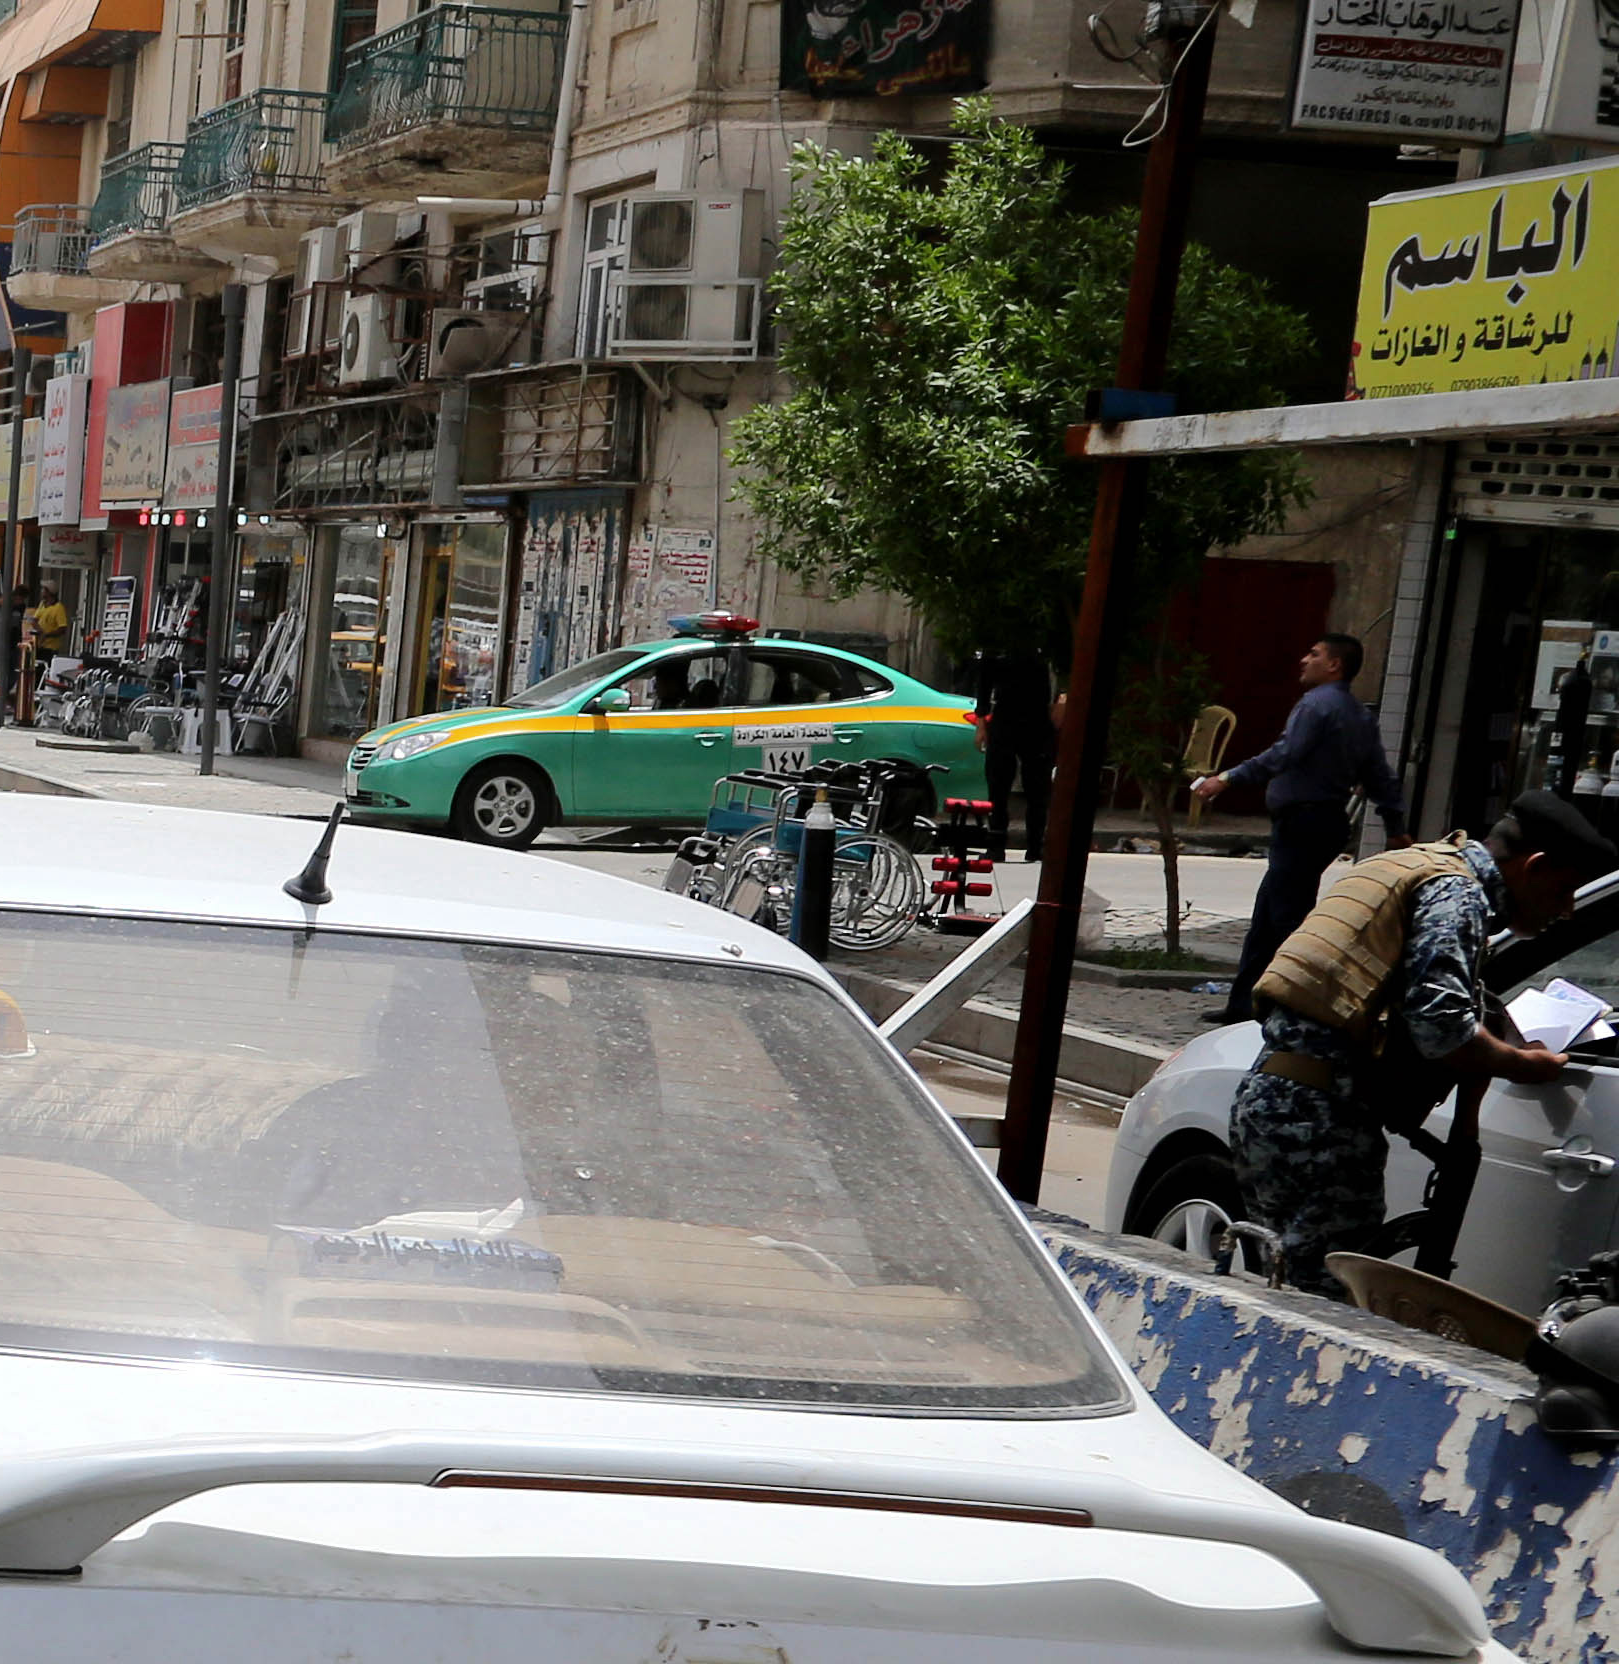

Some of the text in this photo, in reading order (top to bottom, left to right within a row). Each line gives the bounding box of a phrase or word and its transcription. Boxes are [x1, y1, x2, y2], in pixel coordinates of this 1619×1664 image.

[1383, 177, 1591, 323] الباسم
[1371, 322, 1450, 366] الغازات
[1472, 309, 1574, 356] للرشاقة
[736, 727, 832, 743] النجدة العامة الكرادة
[769, 750, 805, 773] ١٤٧
